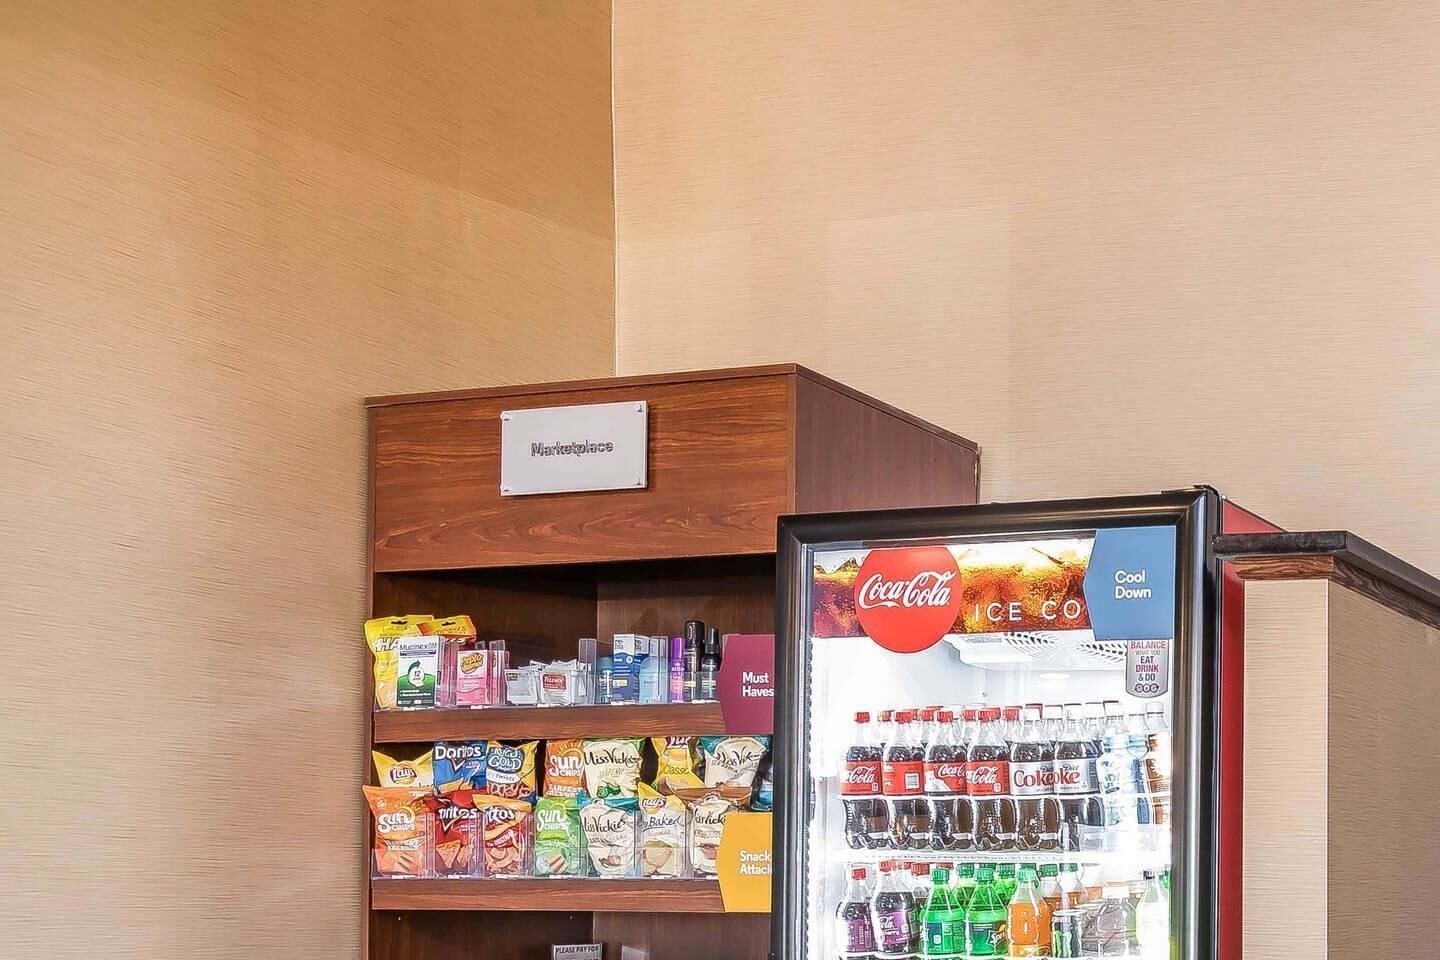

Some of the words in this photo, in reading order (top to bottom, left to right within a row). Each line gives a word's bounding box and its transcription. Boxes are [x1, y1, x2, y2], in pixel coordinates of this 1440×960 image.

[530, 440, 614, 457] Marketplace
[1114, 570, 1146, 584] Cool
[1114, 586, 1152, 600] Down
[975, 602, 1022, 622] ICE
[1041, 599, 1082, 620] CO
[1130, 641, 1166, 650] BALANCE
[1140, 656, 1154, 664] EAT
[1135, 665, 1159, 673] DRINK
[742, 672, 769, 684] Must
[1145, 674, 1156, 682] DO
[742, 685, 775, 697] Haves
[435, 745, 481, 761] Doritos
[487, 755, 522, 770] GOLD
[1053, 767, 1081, 785] oke
[649, 814, 682, 828] Baked
[739, 850, 772, 862] Snack
[555, 946, 575, 954] PLEASE
